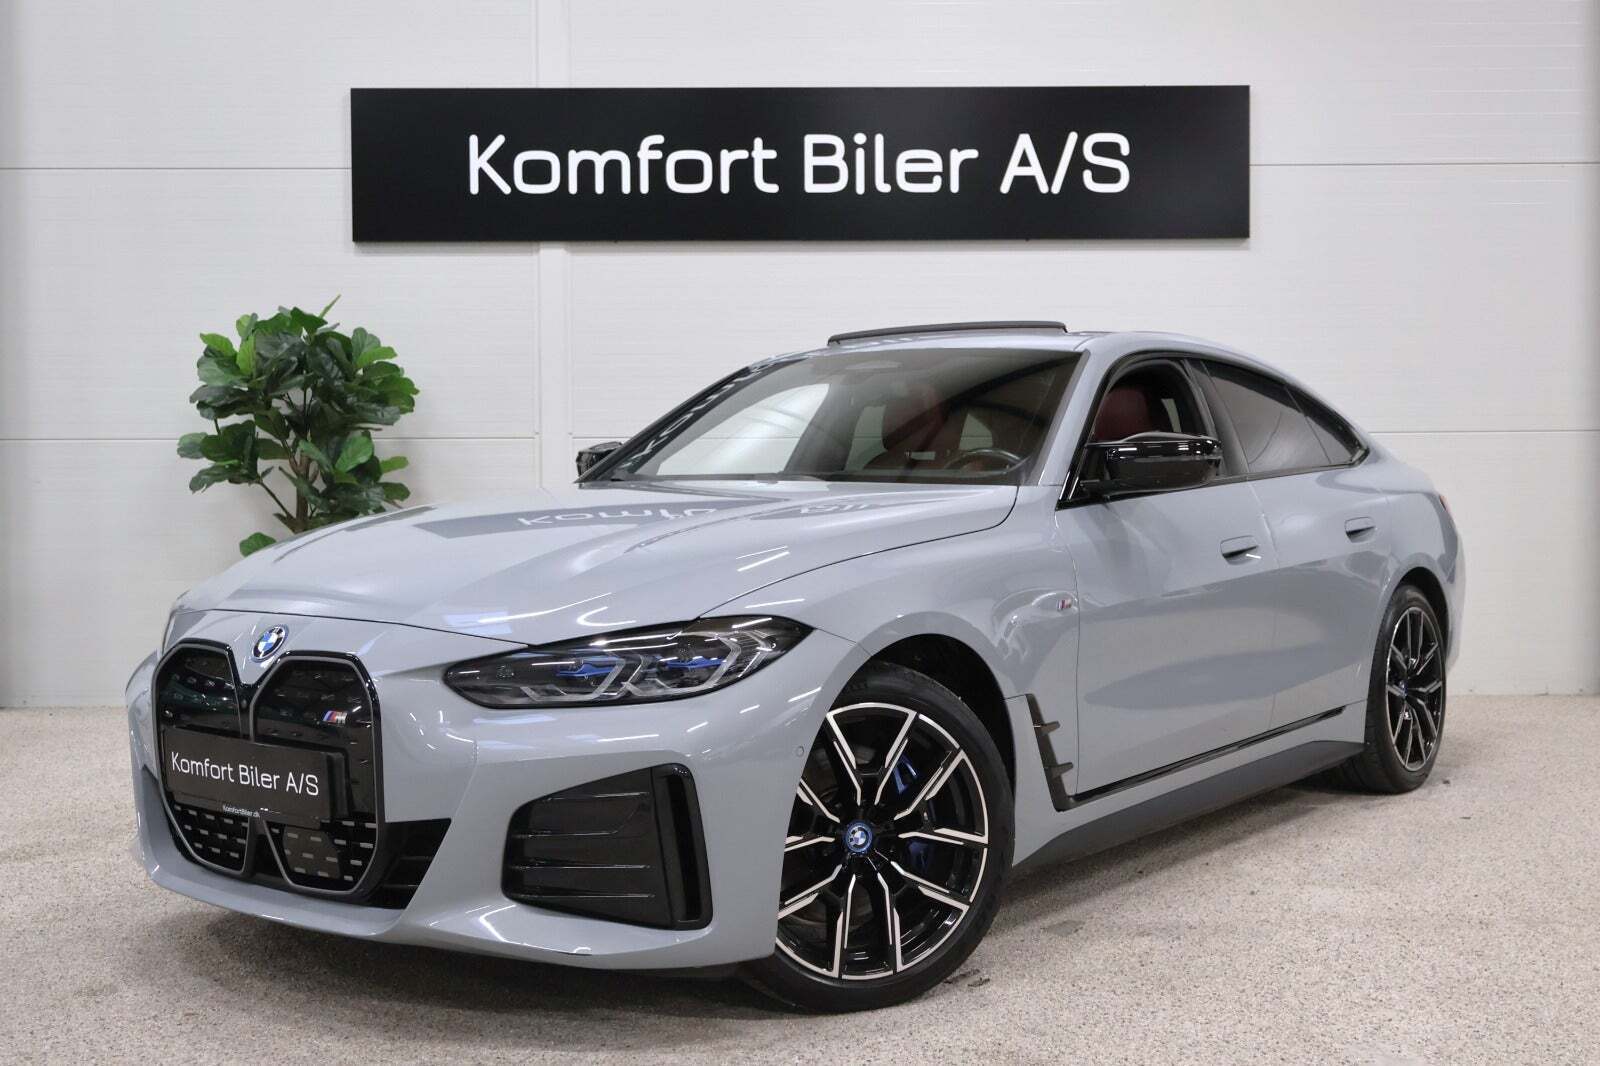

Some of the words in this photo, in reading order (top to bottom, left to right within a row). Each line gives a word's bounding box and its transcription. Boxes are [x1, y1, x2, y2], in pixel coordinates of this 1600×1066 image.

[468, 133, 780, 195] Komfort
[803, 132, 980, 195] Biler
[999, 132, 1131, 195] A/S
[171, 751, 235, 783] Komfort
[238, 763, 281, 790] Biler
[285, 771, 319, 796] A/S
